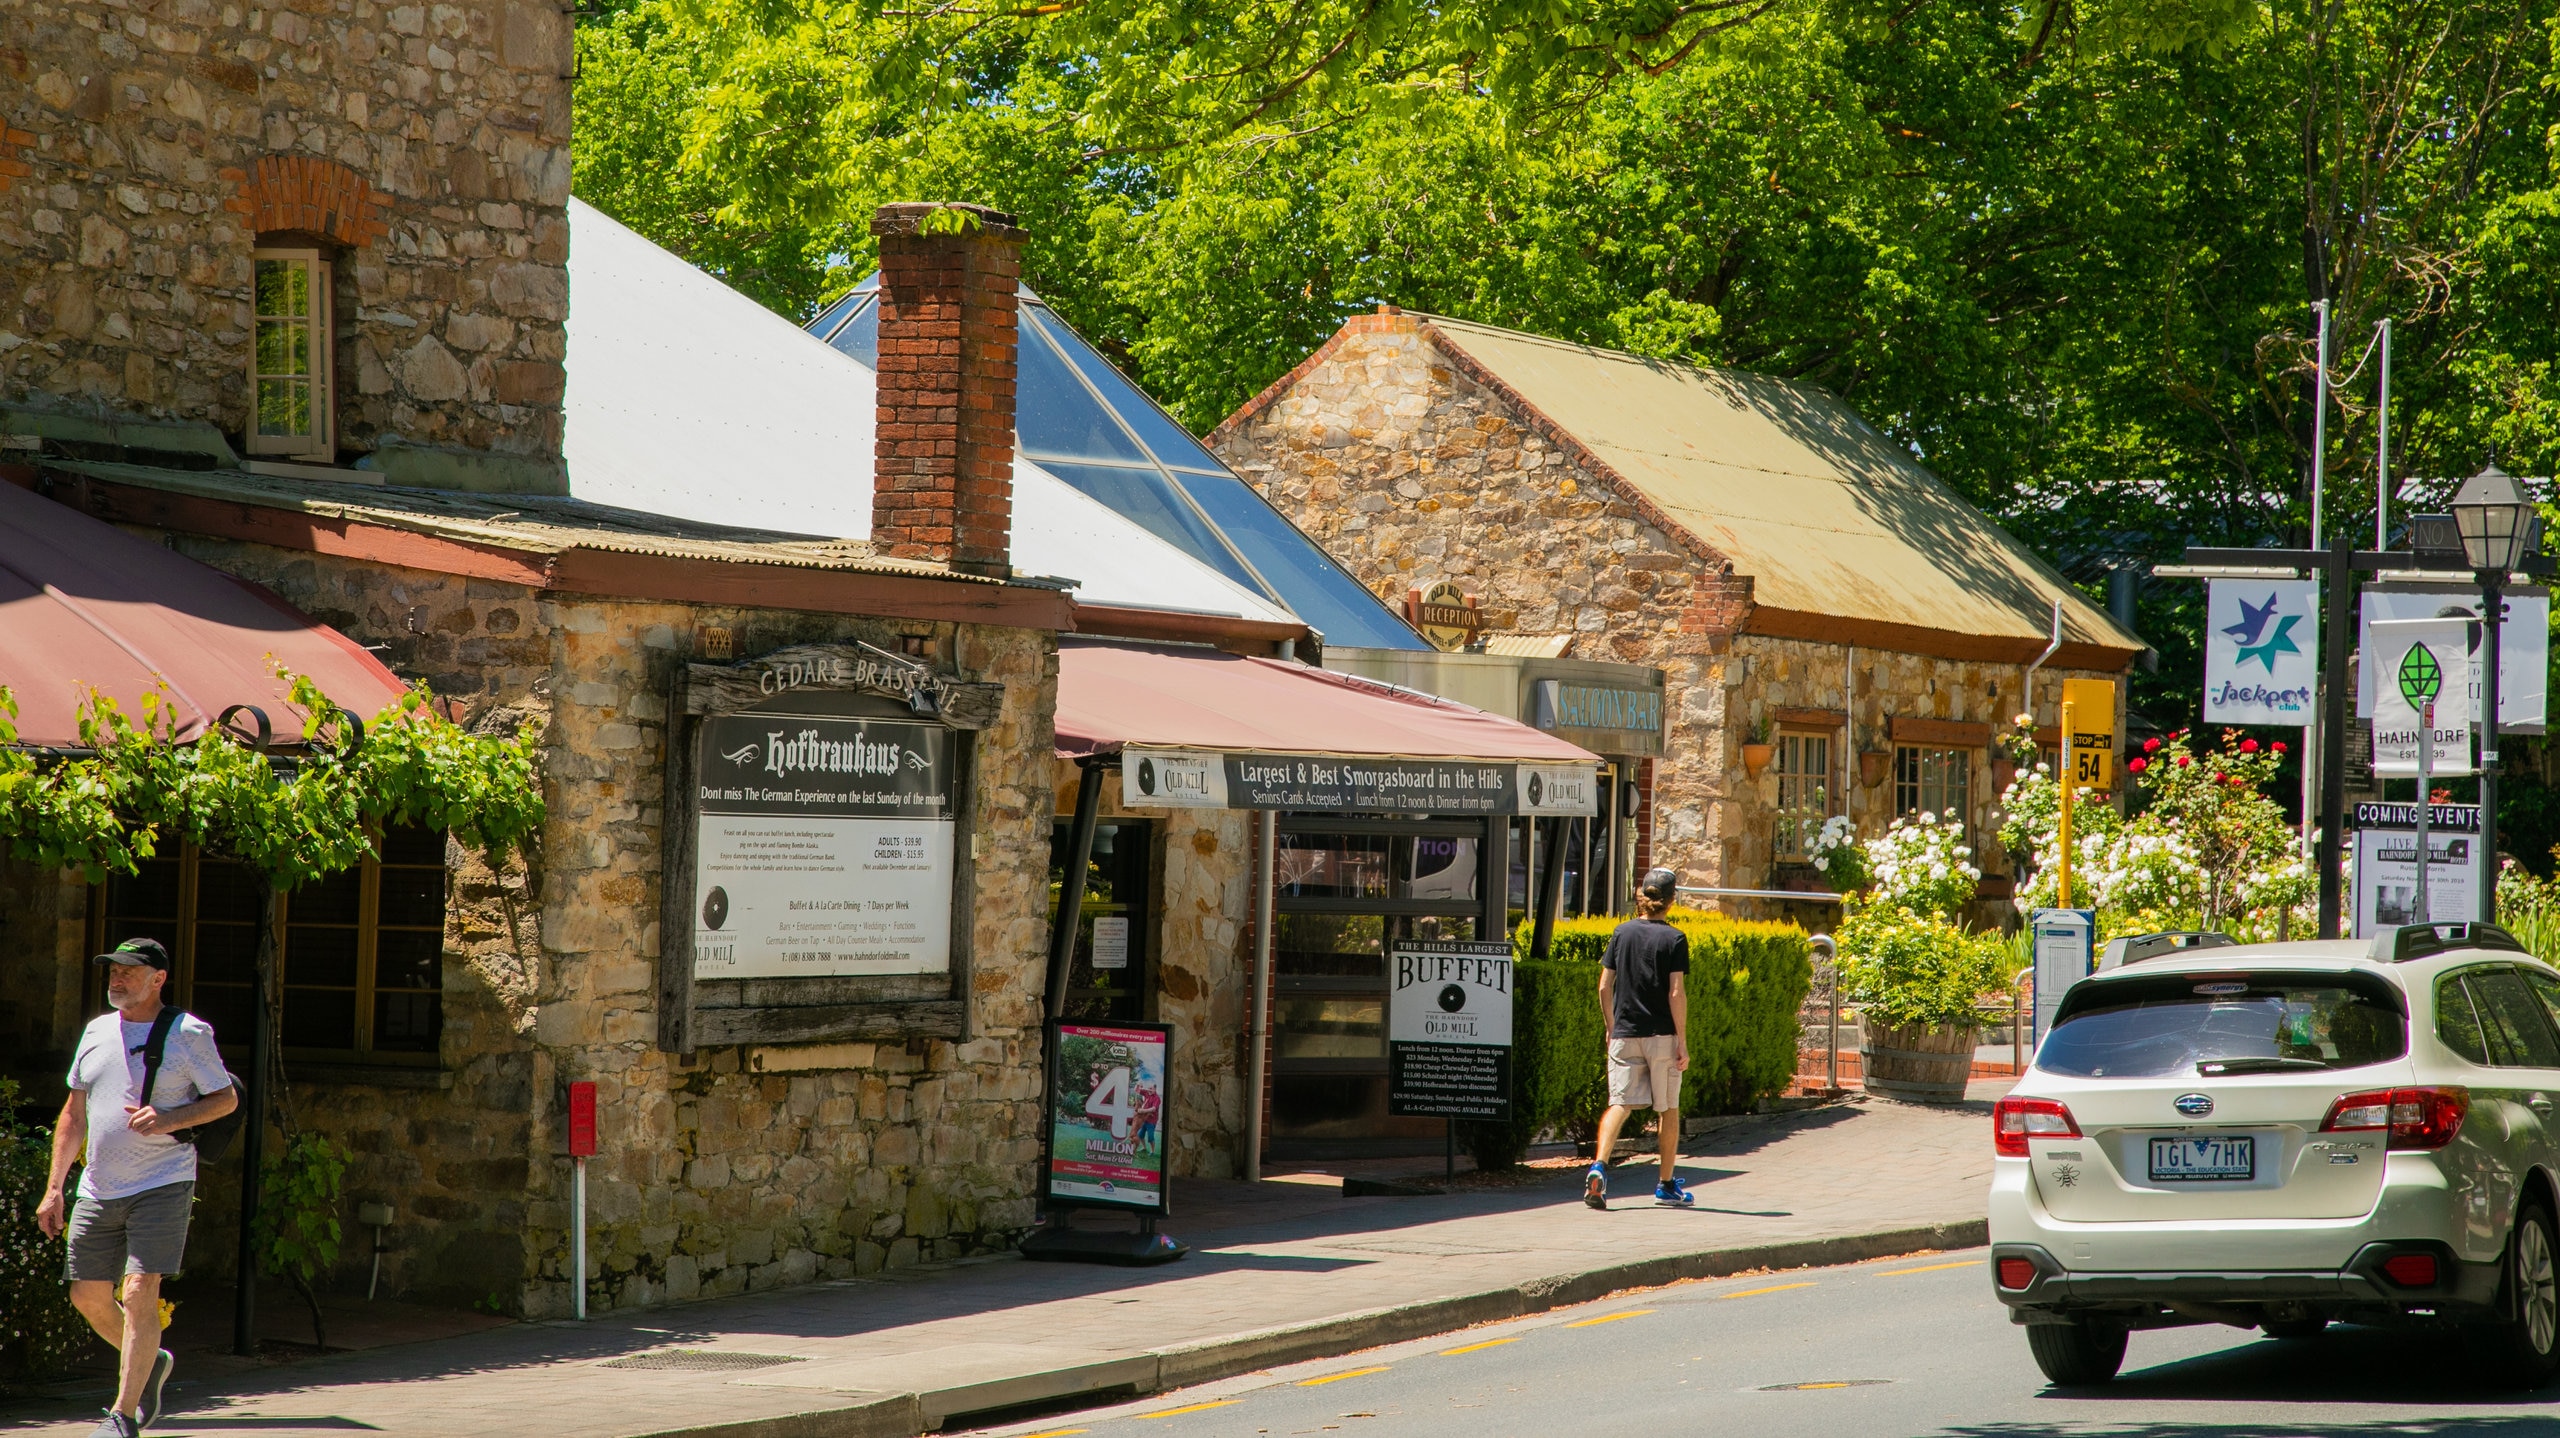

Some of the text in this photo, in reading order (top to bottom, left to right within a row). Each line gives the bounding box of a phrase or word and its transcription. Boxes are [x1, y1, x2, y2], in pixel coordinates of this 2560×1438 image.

[1431, 584, 1463, 605] OLD MILL
[1424, 606, 1478, 626] RECEPTION
[760, 658, 842, 695] CEDARS
[2212, 680, 2310, 708] jackpot
[1559, 686, 1659, 731] SALOON BAR
[2278, 703, 2300, 711] club
[2074, 736, 2093, 745] STOP
[2379, 729, 2465, 744] HAHNORF
[764, 728, 900, 778] Hofbrauhaus
[2078, 753, 2100, 782] 54
[1165, 769, 1208, 794] OLD MILL
[1240, 761, 1503, 792] Largest & Best Smorgasboard in the Hills
[701, 786, 946, 807] Dont miss The German Experience on the last Sunday of the month
[1252, 789, 1495, 812] Seniors Cards Accepted Lunch from 12 noon & Dinner from 6pm
[1549, 782, 1584, 804] OLD MILL
[2359, 804, 2481, 825] COMING EVENTS
[878, 837, 922, 846] ADULTS $39.90
[1418, 840, 1466, 857] TION
[2387, 838, 2412, 849] LIVE
[874, 850, 924, 859] CHILDREN $15.95
[2380, 850, 2416, 860] HAHNDORF
[2433, 850, 2450, 860] MILL
[789, 900, 808, 910] Buffet
[808, 901, 814, 910] &
[820, 901, 827, 910] La
[827, 901, 842, 910] Carte
[843, 901, 861, 912] Dining
[871, 901, 885, 912] Days
[885, 902, 895, 912] per
[895, 901, 909, 910] Week
[779, 921, 916, 932] Bars Entertainment Gaming Weddings Functions
[694, 944, 736, 965] LD MILL
[1398, 942, 1509, 955] THE HILLS LARGEST
[1396, 955, 1510, 995] BUFFET
[1100, 1030, 1129, 1039] millionaires
[1425, 1020, 1478, 1037] OLD MILL
[1398, 1045, 1416, 1053] Lunch
[1416, 1045, 1430, 1053] from
[1491, 1048, 1504, 1057] 6pm
[1441, 1055, 1473, 1064] Wednesday
[1477, 1057, 1496, 1066] Friday
[1422, 1064, 1441, 1072] Cheap
[1441, 1064, 1470, 1073] Chewsday
[1470, 1065, 1498, 1075] (Tuesday)
[1448, 1073, 1462, 1082] night
[1463, 1074, 1498, 1083] (Wednesday)
[1422, 1081, 1458, 1090] Hofbrauhaus
[1467, 1083, 1498, 1092] discounts)
[1435, 1094, 1454, 1102] Sunday
[1466, 1095, 1483, 1103] Public
[1483, 1096, 1507, 1105] Holidays
[1436, 1105, 1460, 1113] DINING
[1461, 1106, 1496, 1114] AVAILABLE
[1086, 1139, 1134, 1155] MILLION
[1098, 1153, 1111, 1161] Mon
[1118, 1156, 1133, 1164] Wed
